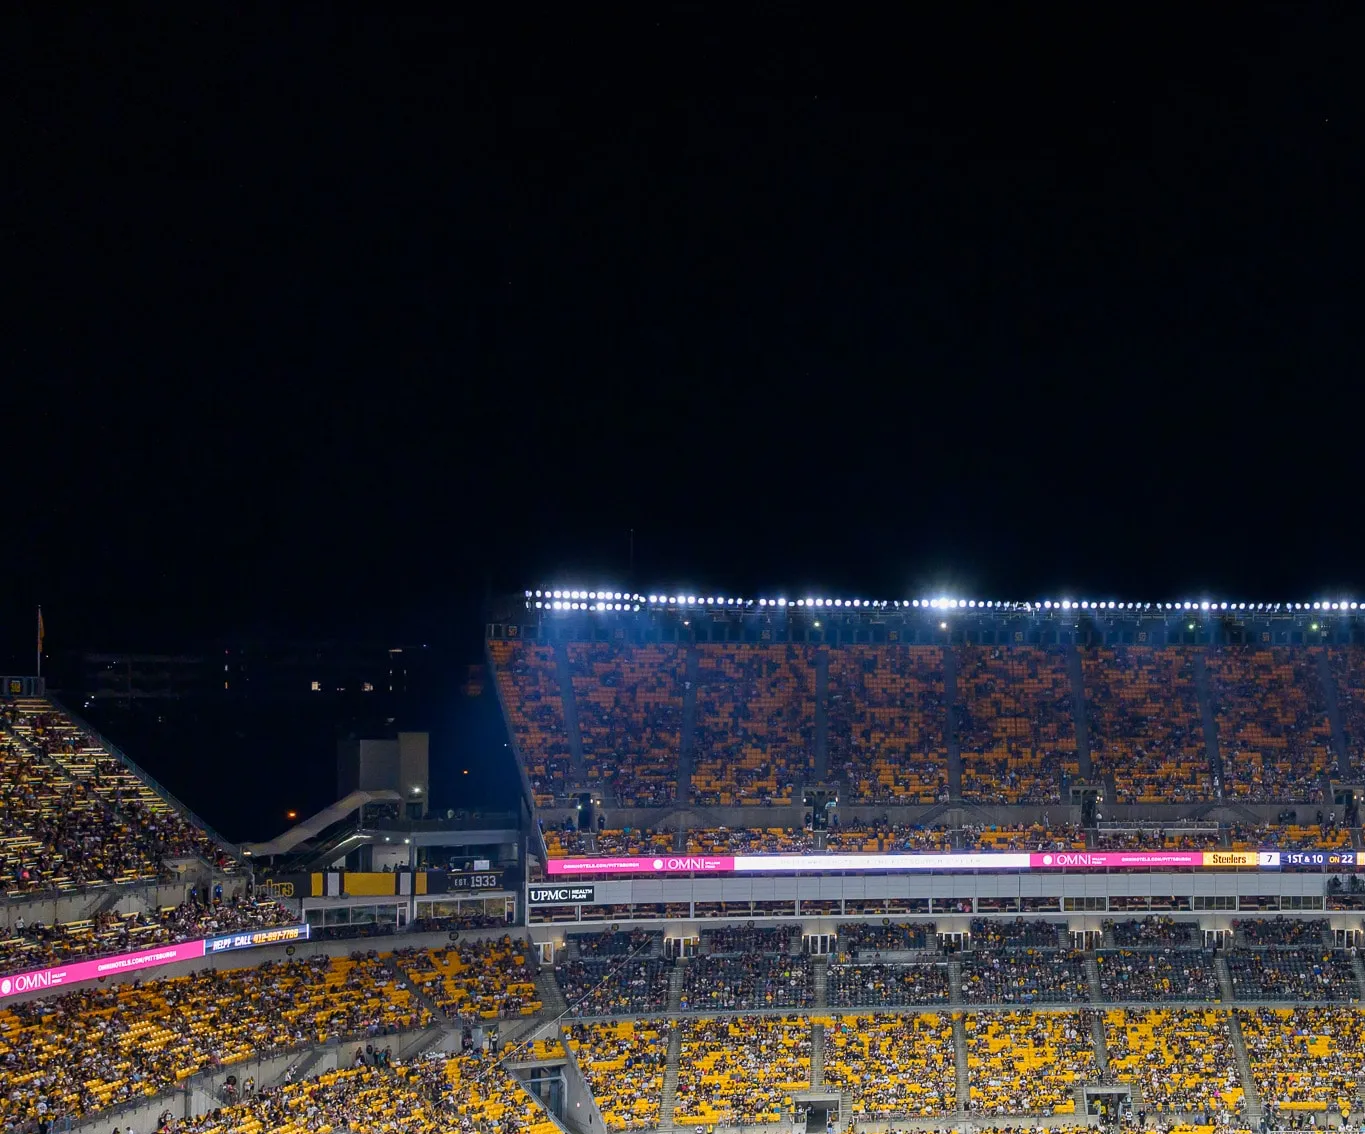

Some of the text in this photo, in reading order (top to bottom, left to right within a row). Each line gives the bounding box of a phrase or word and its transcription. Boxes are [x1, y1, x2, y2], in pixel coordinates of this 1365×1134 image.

[667, 858, 705, 870] OMNI
[1056, 854, 1091, 866] OMNI
[1212, 853, 1247, 866] Steelers
[1266, 855, 1273, 863] 7
[1287, 854, 1303, 864] 1ST
[1311, 854, 1323, 864] 10
[1329, 856, 1340, 864] ON
[1341, 854, 1353, 864] 22
[454, 875, 497, 888] EST. 1933
[530, 888, 568, 901] UPMC
[234, 935, 252, 948] CALL
[15, 972, 50, 992] OMNI
